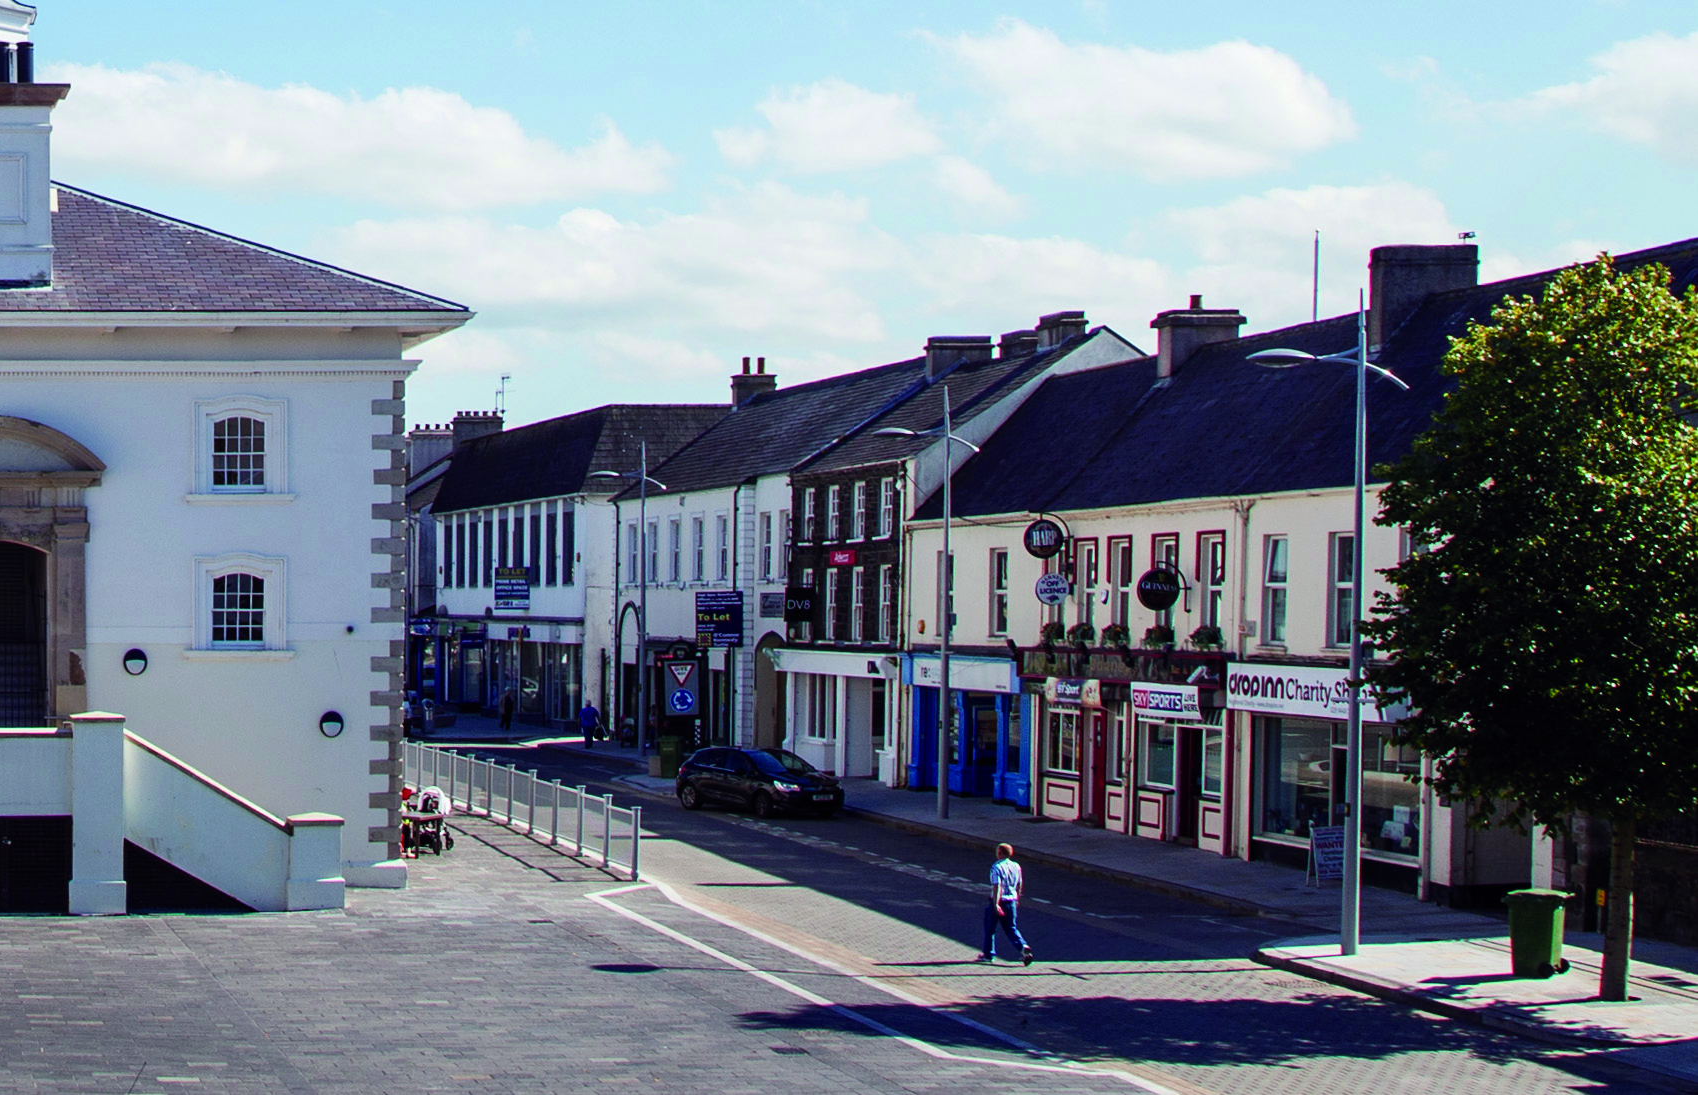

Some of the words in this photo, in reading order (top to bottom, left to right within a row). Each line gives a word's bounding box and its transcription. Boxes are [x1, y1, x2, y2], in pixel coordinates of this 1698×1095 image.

[1032, 530, 1057, 546] HARP
[1039, 587, 1067, 595] LICENCE
[1141, 581, 1178, 592] GUINNESS
[787, 599, 811, 610] DV8
[697, 613, 710, 621] To
[713, 612, 730, 621] Let
[1286, 677, 1332, 708] Charity
[1133, 691, 1148, 707] SKY
[1149, 693, 1182, 710] SPORTS
[1184, 693, 1196, 703] LIVE
[1184, 704, 1199, 712] HERE
[1315, 841, 1344, 850] WANTE
